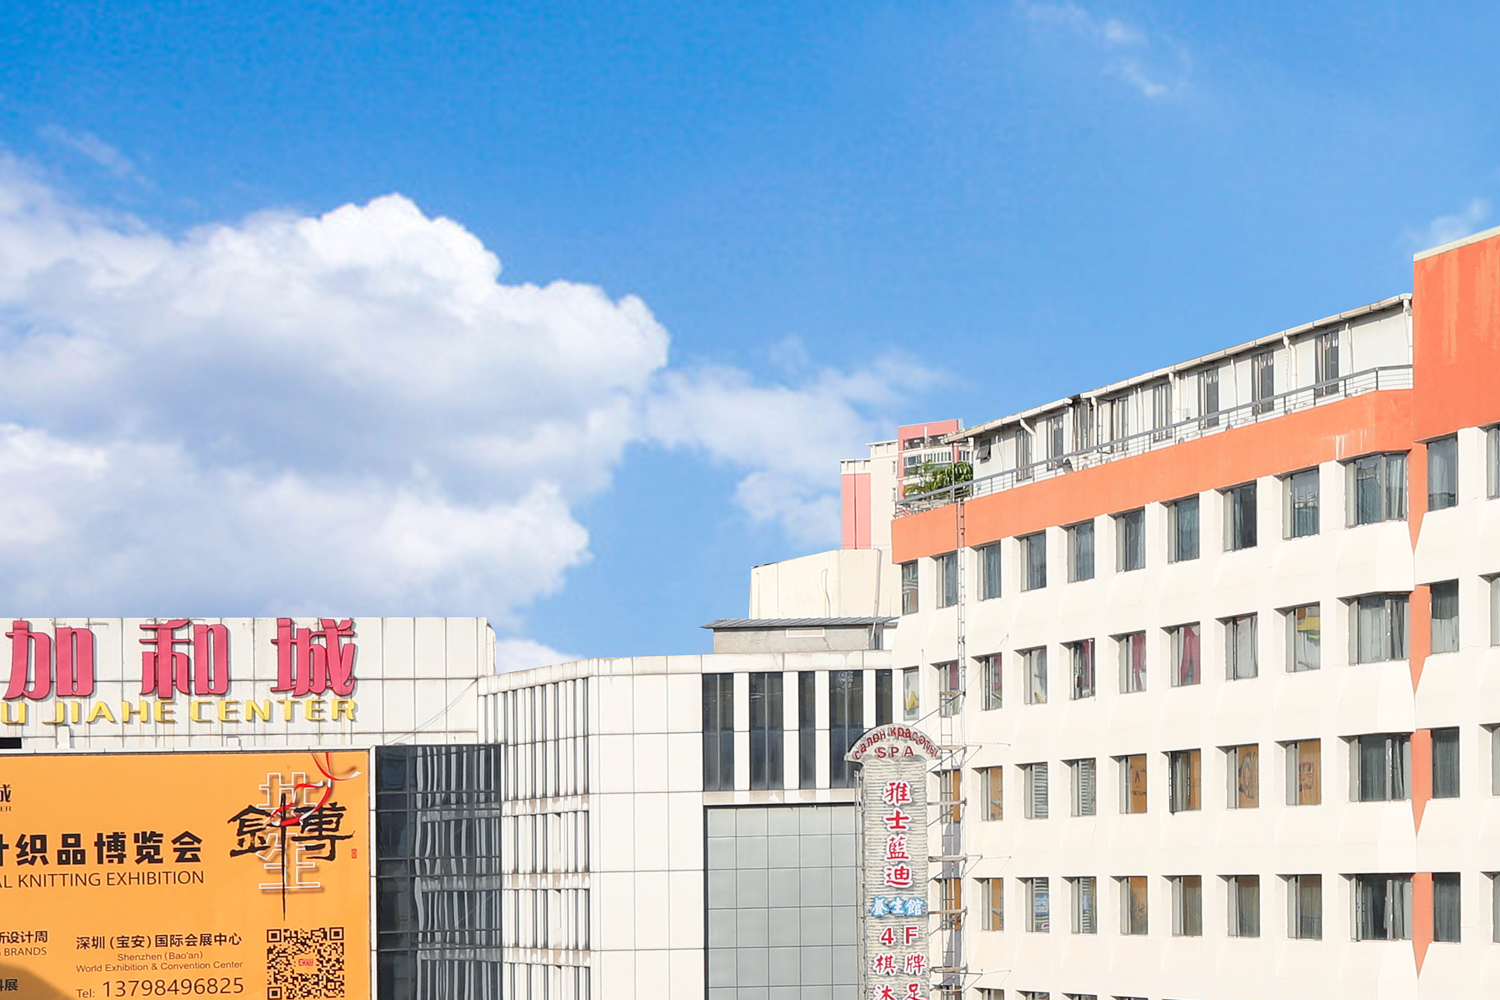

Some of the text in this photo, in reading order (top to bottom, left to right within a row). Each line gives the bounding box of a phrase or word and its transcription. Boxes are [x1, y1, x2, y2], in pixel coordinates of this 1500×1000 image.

[3, 618, 356, 699] 加和城
[42, 700, 176, 724] JIAHE
[190, 699, 356, 722] CENTER
[877, 746, 914, 758] SPA
[883, 781, 911, 886] 雅士藍迪
[18, 872, 101, 888] KNITTING
[106, 870, 204, 886] EXHIBITION
[870, 896, 925, 917] 養生館
[4, 946, 47, 957] BRANDS
[117, 953, 162, 962] Shenzhen
[76, 960, 243, 973] World Exhibition & Convention Center
[875, 954, 926, 974] 棋牌
[76, 977, 244, 998] Tel: 13798496825
